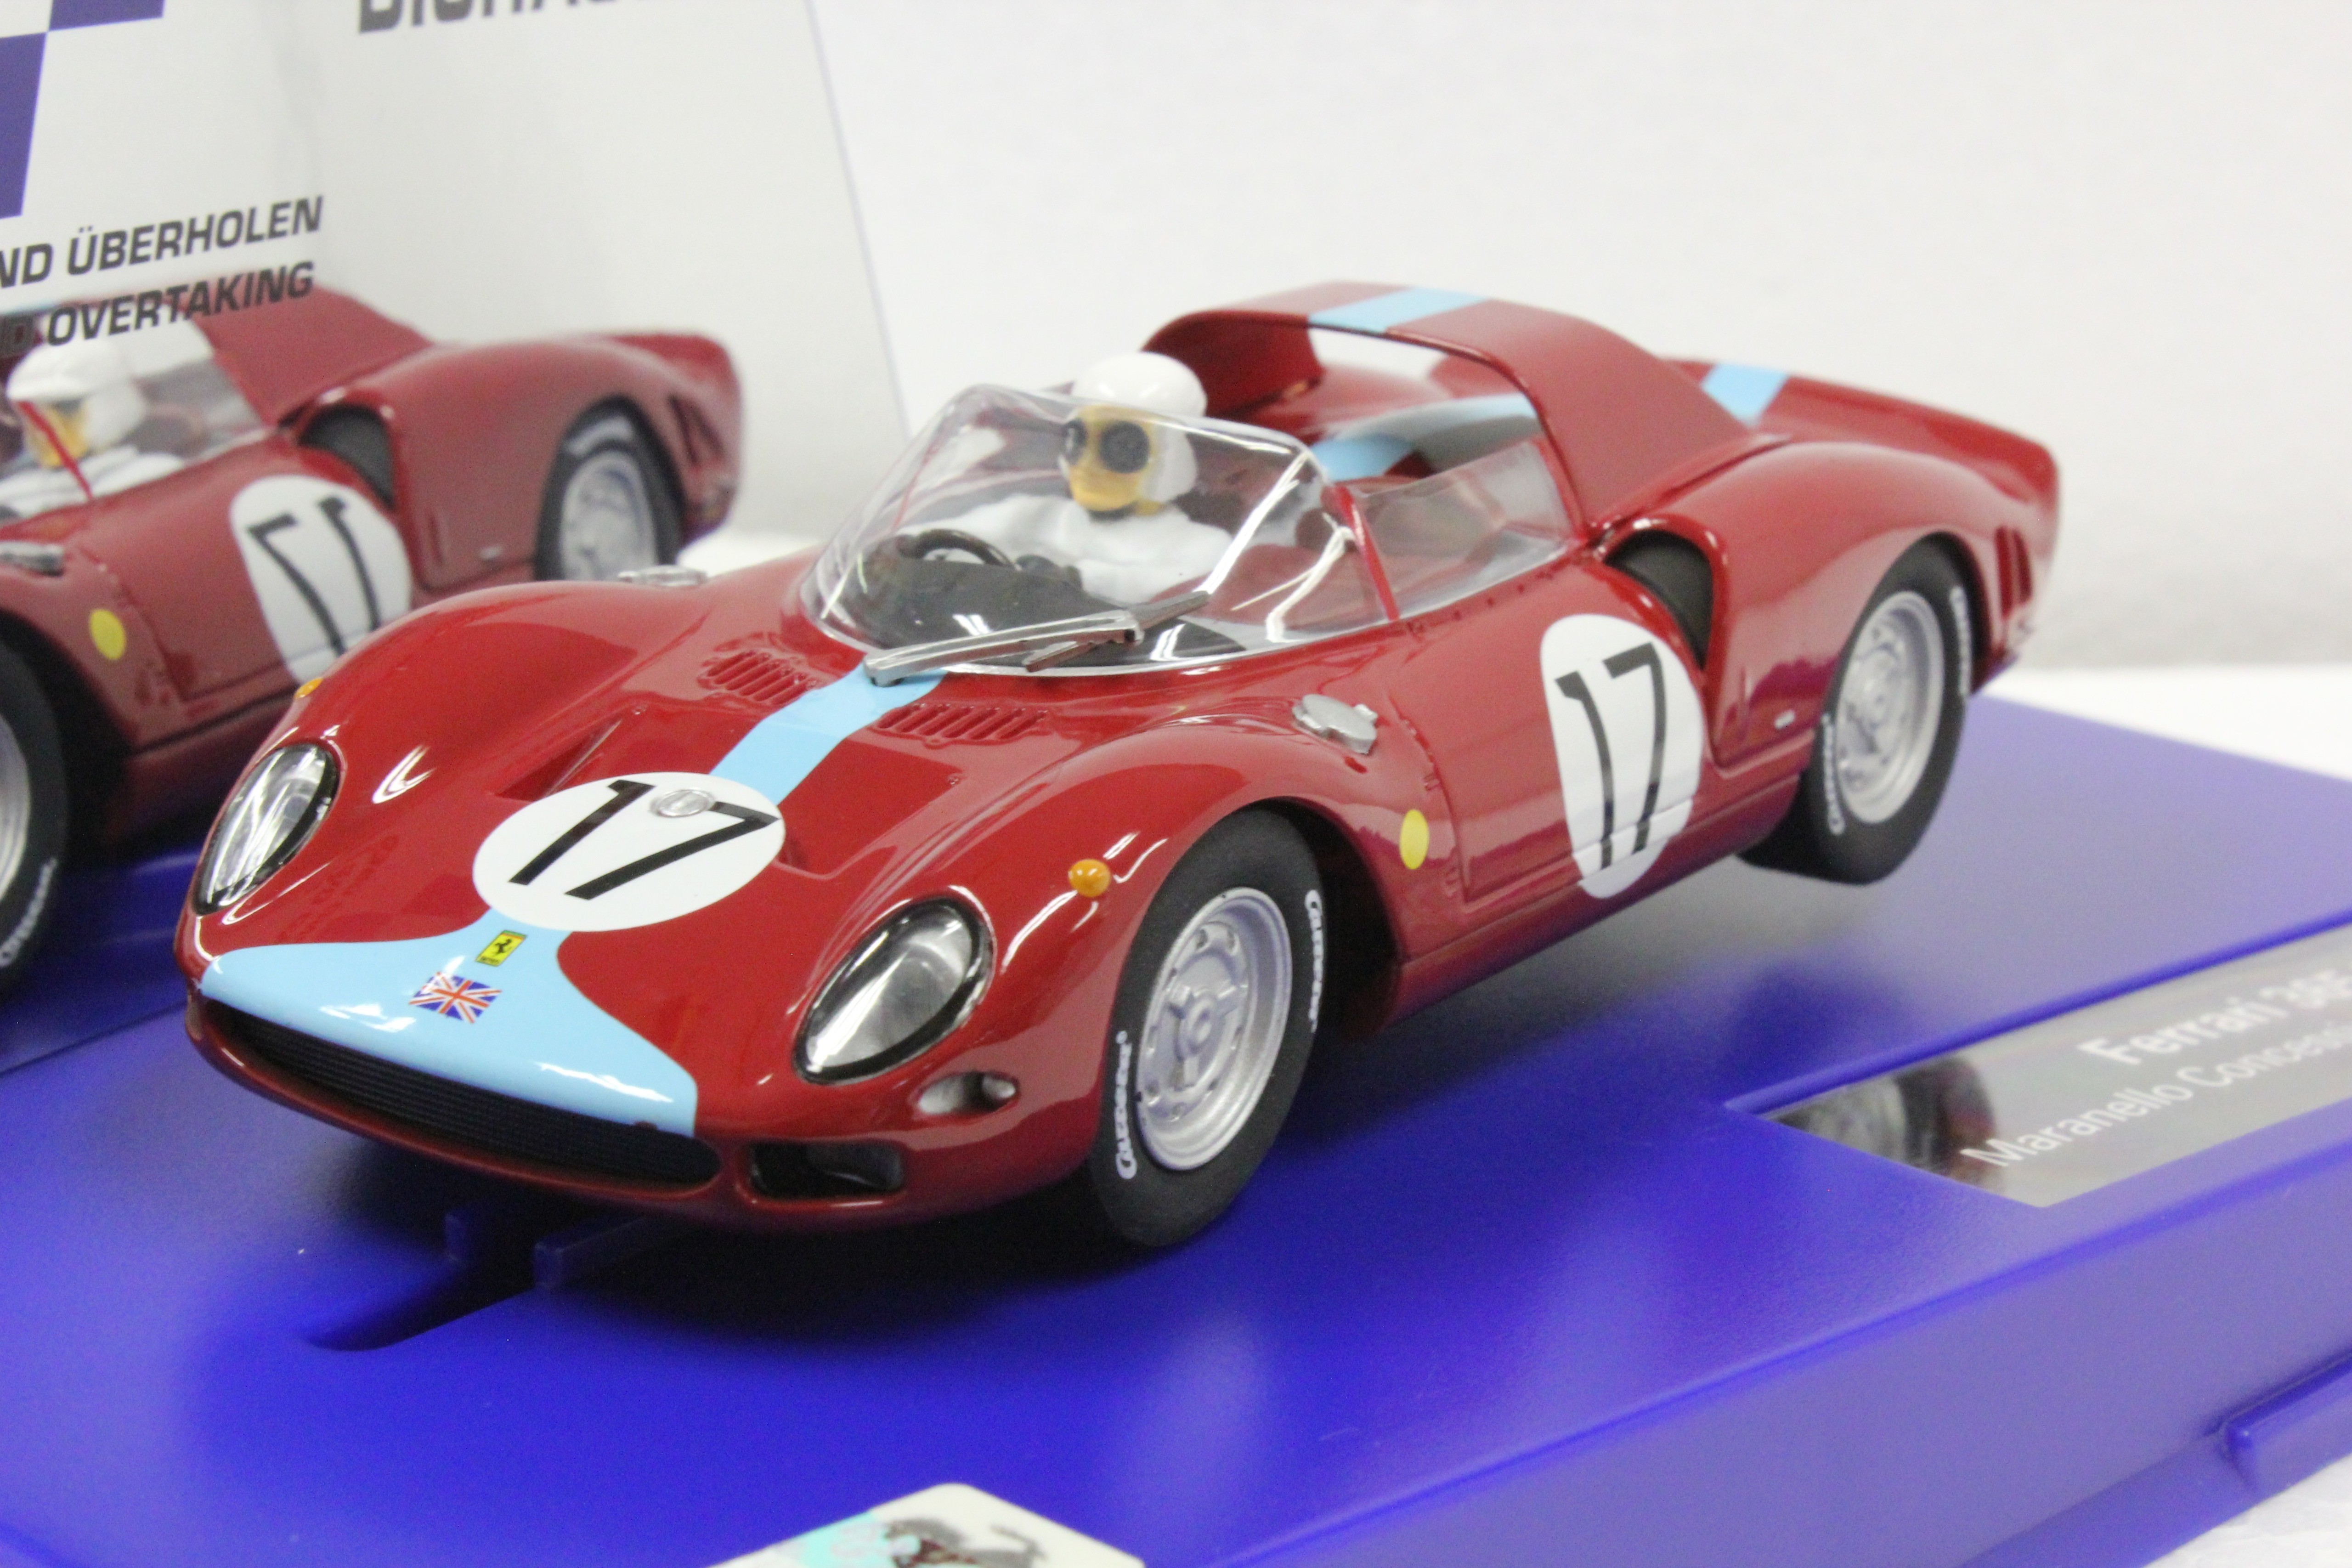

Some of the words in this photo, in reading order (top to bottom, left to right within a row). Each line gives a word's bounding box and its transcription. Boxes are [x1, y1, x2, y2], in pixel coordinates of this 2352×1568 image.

[67, 196, 324, 276] ÜBERHOLEN
[47, 260, 315, 346] OVERTAKING
[1554, 642, 1667, 871] 17
[508, 779, 780, 900] 17
[1959, 1082, 2194, 1167] Maranello
